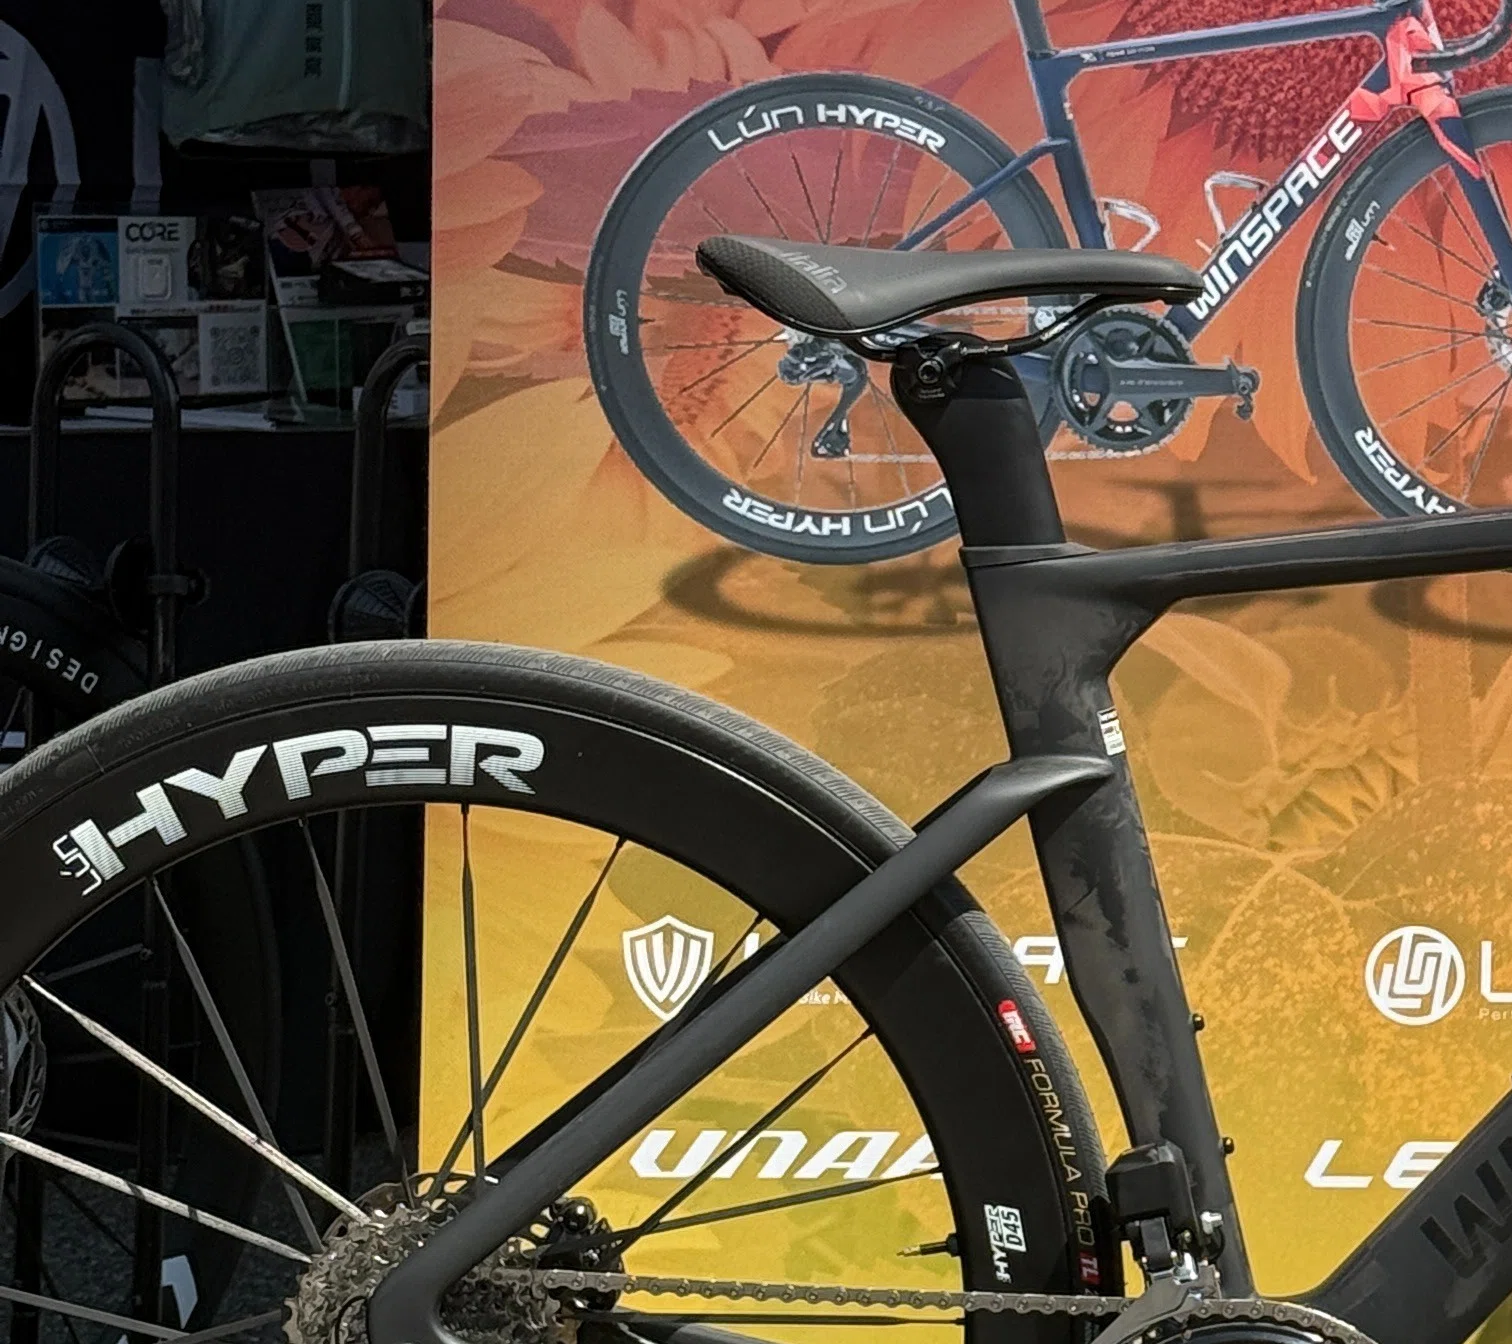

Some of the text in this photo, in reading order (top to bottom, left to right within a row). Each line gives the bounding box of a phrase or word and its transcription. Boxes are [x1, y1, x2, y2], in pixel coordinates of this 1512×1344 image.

[816, 103, 946, 155] HYPER
[125, 222, 180, 243] CORE
[1187, 109, 1363, 321] WINSPACE
[722, 486, 851, 537] HYPER
[70, 723, 545, 881] HYPER
[1025, 1057, 1083, 1183] FORMULA
[1070, 1189, 1095, 1247] PRO
[1001, 1207, 1023, 1251] D45
